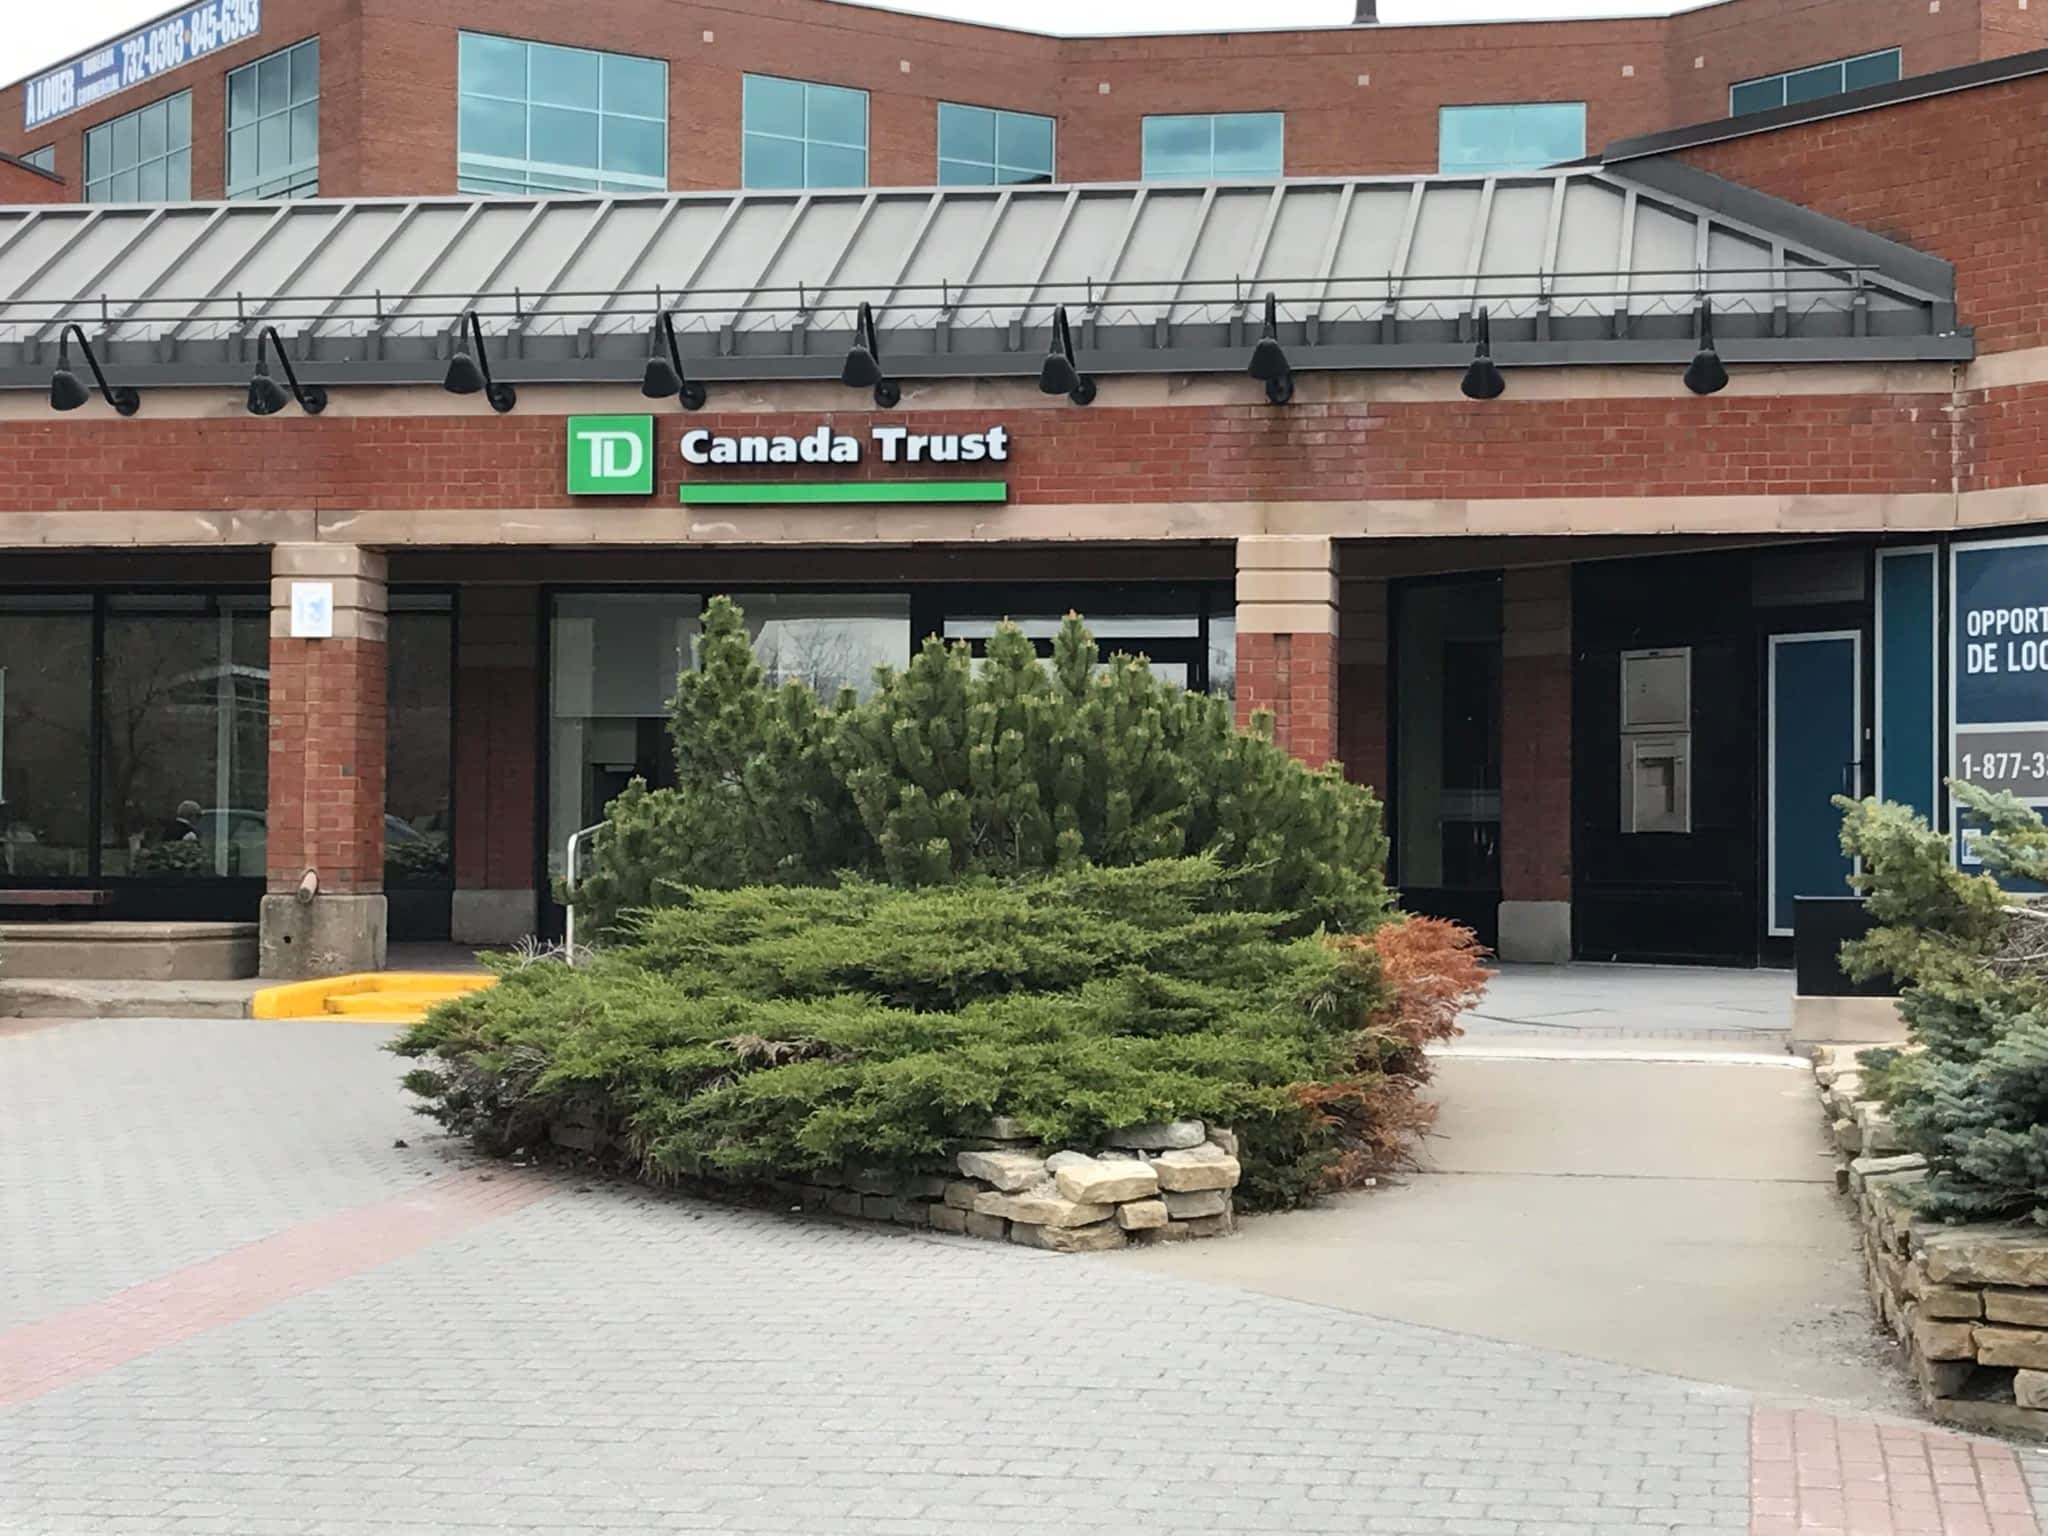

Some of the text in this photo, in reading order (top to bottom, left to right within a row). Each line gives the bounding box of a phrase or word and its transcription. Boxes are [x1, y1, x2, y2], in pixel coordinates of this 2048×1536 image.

[37, 68, 75, 122] LOUER
[577, 425, 1008, 478] TD Canada Trust
[1967, 606, 2048, 637] OPPORT
[1967, 643, 1998, 674] DE
[1962, 752, 2048, 780] 1-877-3
